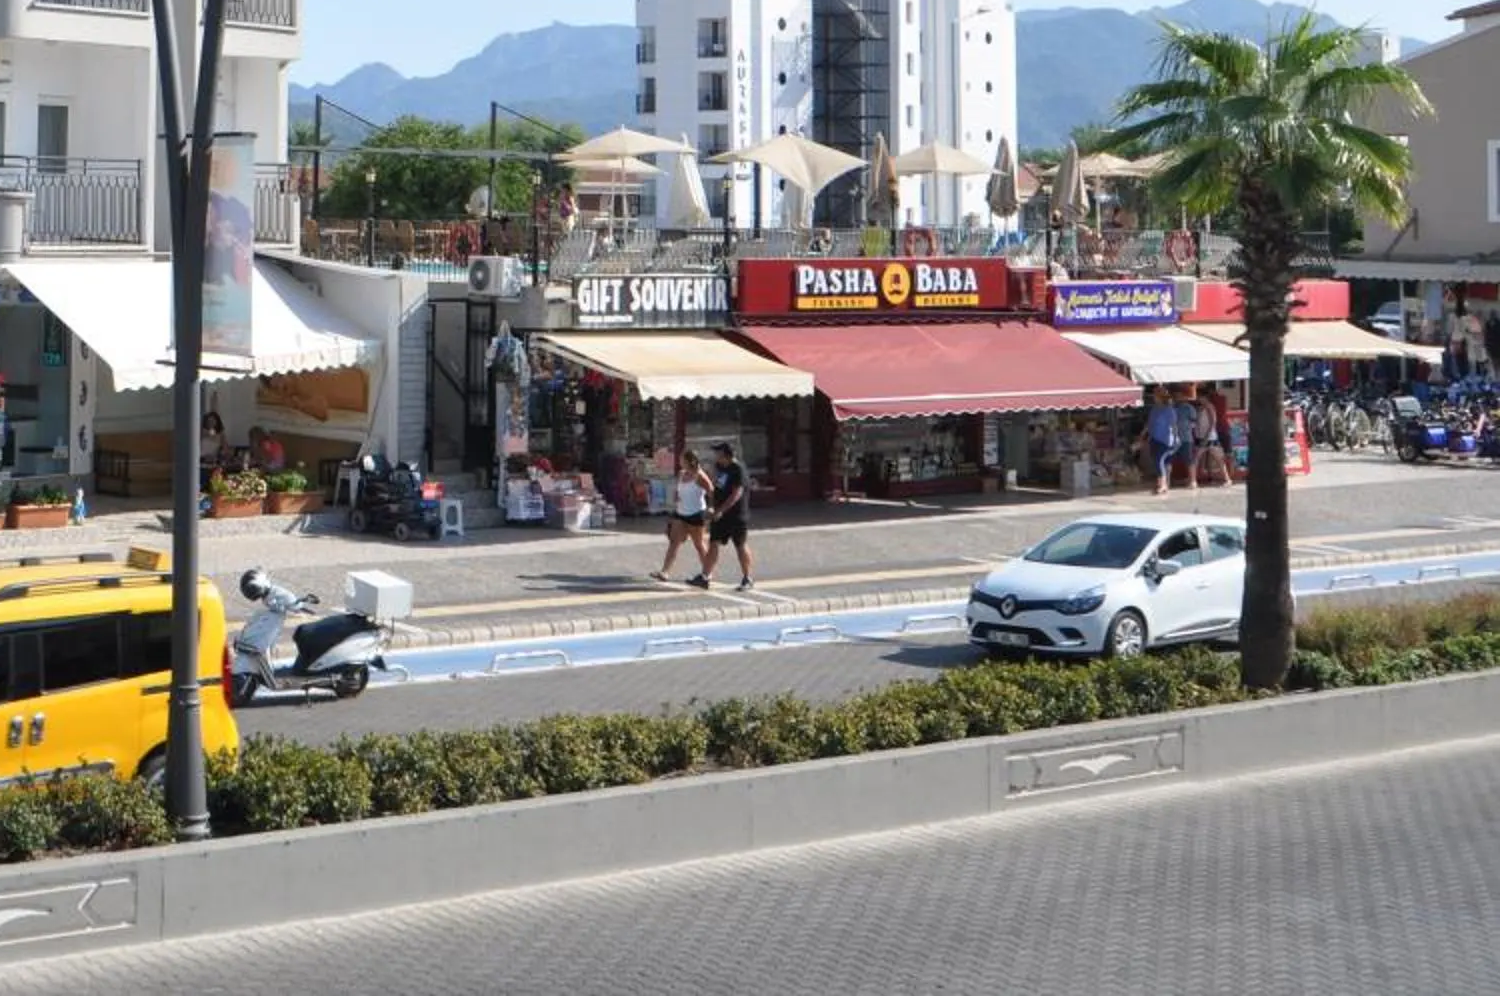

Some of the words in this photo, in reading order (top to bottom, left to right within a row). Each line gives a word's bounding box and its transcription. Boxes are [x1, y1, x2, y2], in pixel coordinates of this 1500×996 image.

[797, 264, 876, 294] PASHA
[915, 263, 977, 292] BABA
[577, 279, 623, 313] GIFT
